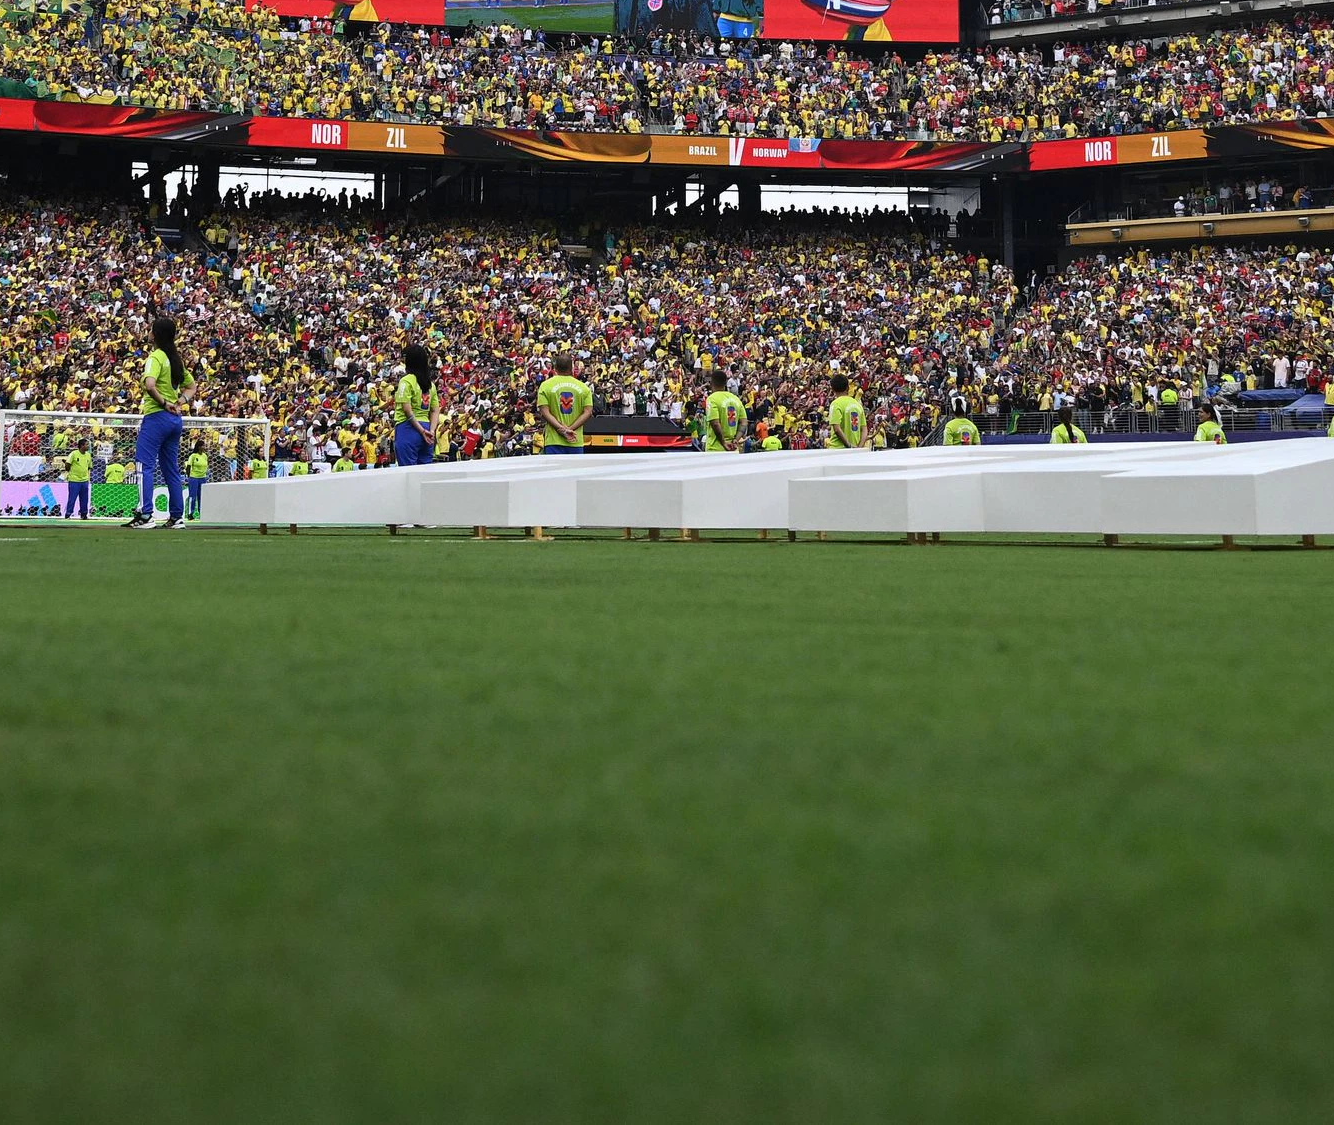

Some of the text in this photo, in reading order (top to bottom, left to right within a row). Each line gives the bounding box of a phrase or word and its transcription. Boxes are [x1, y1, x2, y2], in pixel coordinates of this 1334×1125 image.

[311, 123, 341, 145] NOR
[386, 127, 407, 148] ZIL
[688, 137, 788, 166] BRAZIL V NORWAY
[1084, 141, 1112, 162] NOR
[1151, 136, 1171, 157] ZIL
